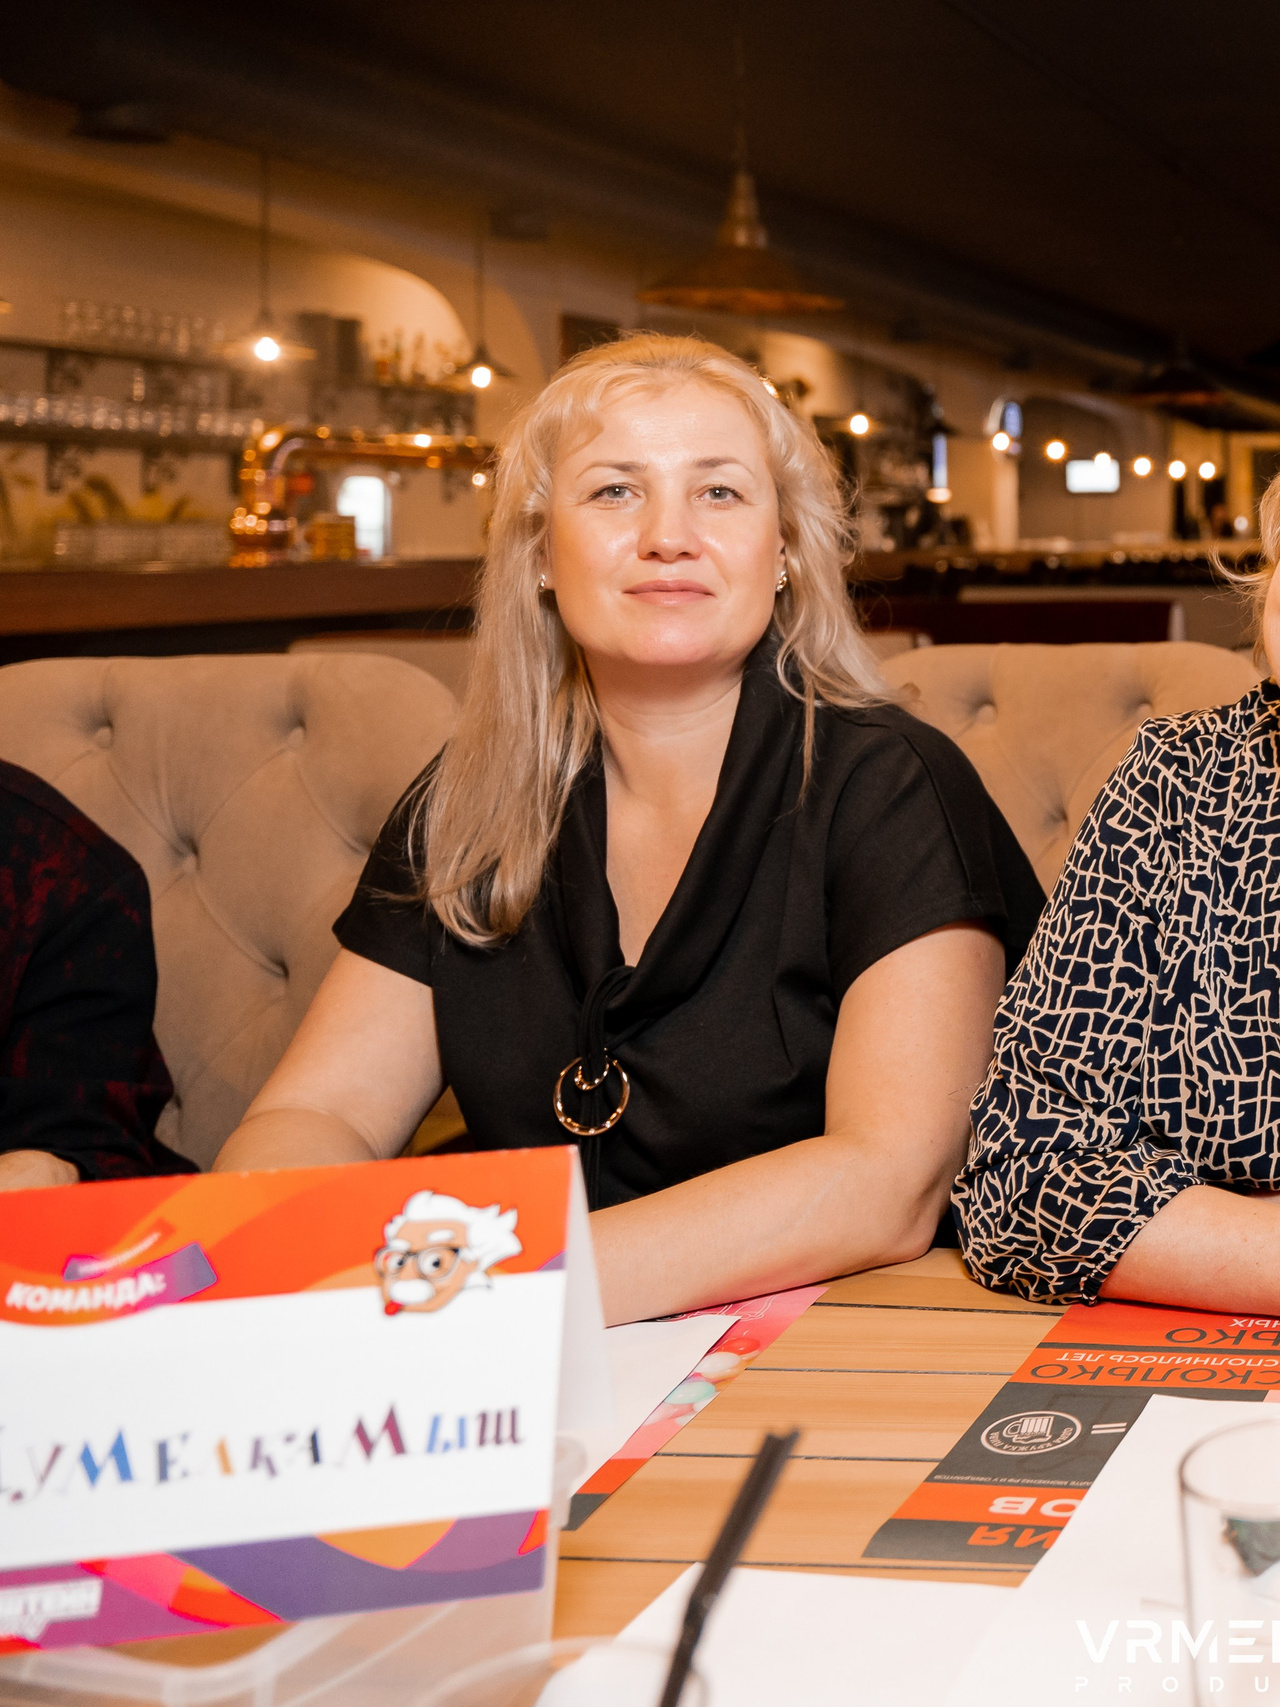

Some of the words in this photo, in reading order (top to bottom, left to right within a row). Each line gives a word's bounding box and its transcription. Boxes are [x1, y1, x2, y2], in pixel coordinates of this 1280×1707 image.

[6, 1272, 167, 1312] КОМАНДА:
[1056, 1352, 1105, 1362] ЛЕТ
[1003, 1441, 1053, 1452] КРУЖКА
[989, 1496, 1083, 1517] ОВ
[967, 1525, 1063, 1549] ИЯ
